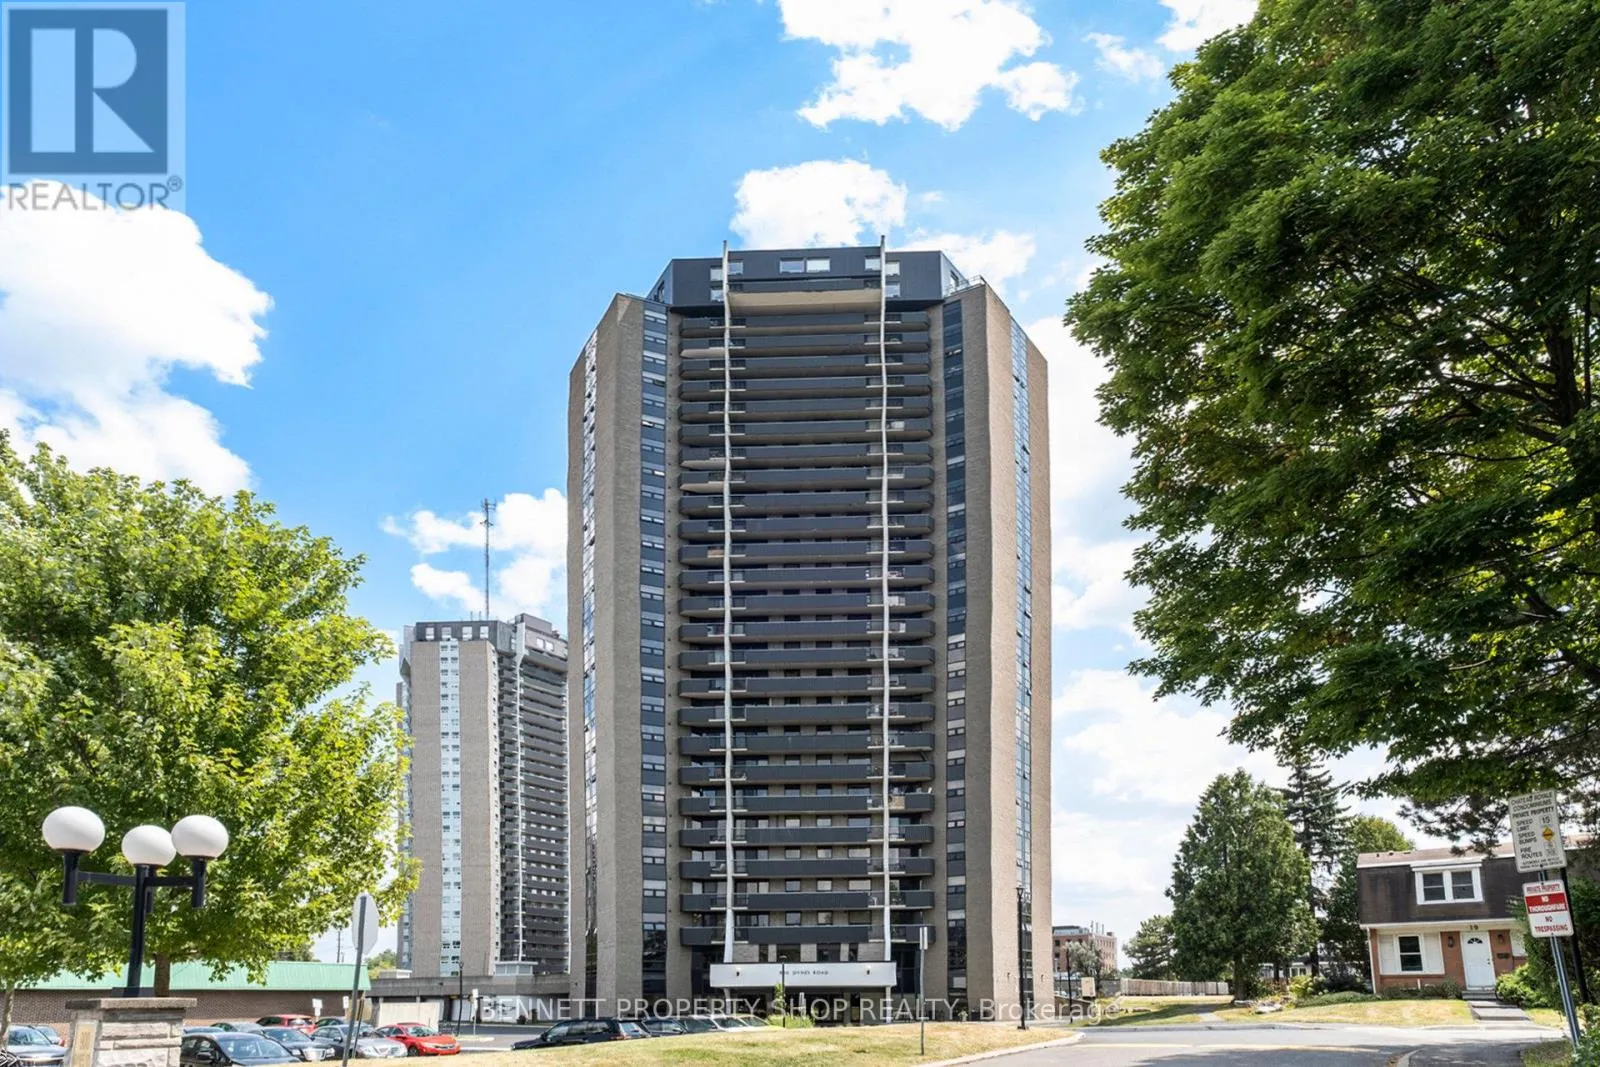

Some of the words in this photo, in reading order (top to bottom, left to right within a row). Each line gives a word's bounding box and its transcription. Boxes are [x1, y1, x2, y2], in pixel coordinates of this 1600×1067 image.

[1512, 810, 1530, 819] PRIVATE
[1530, 806, 1554, 816] PROPERTY
[1542, 816, 1551, 824] 15
[1518, 831, 1536, 839] SPEED
[1521, 851, 1543, 859] ROUTES
[1534, 924, 1568, 932] TRESPASSING
